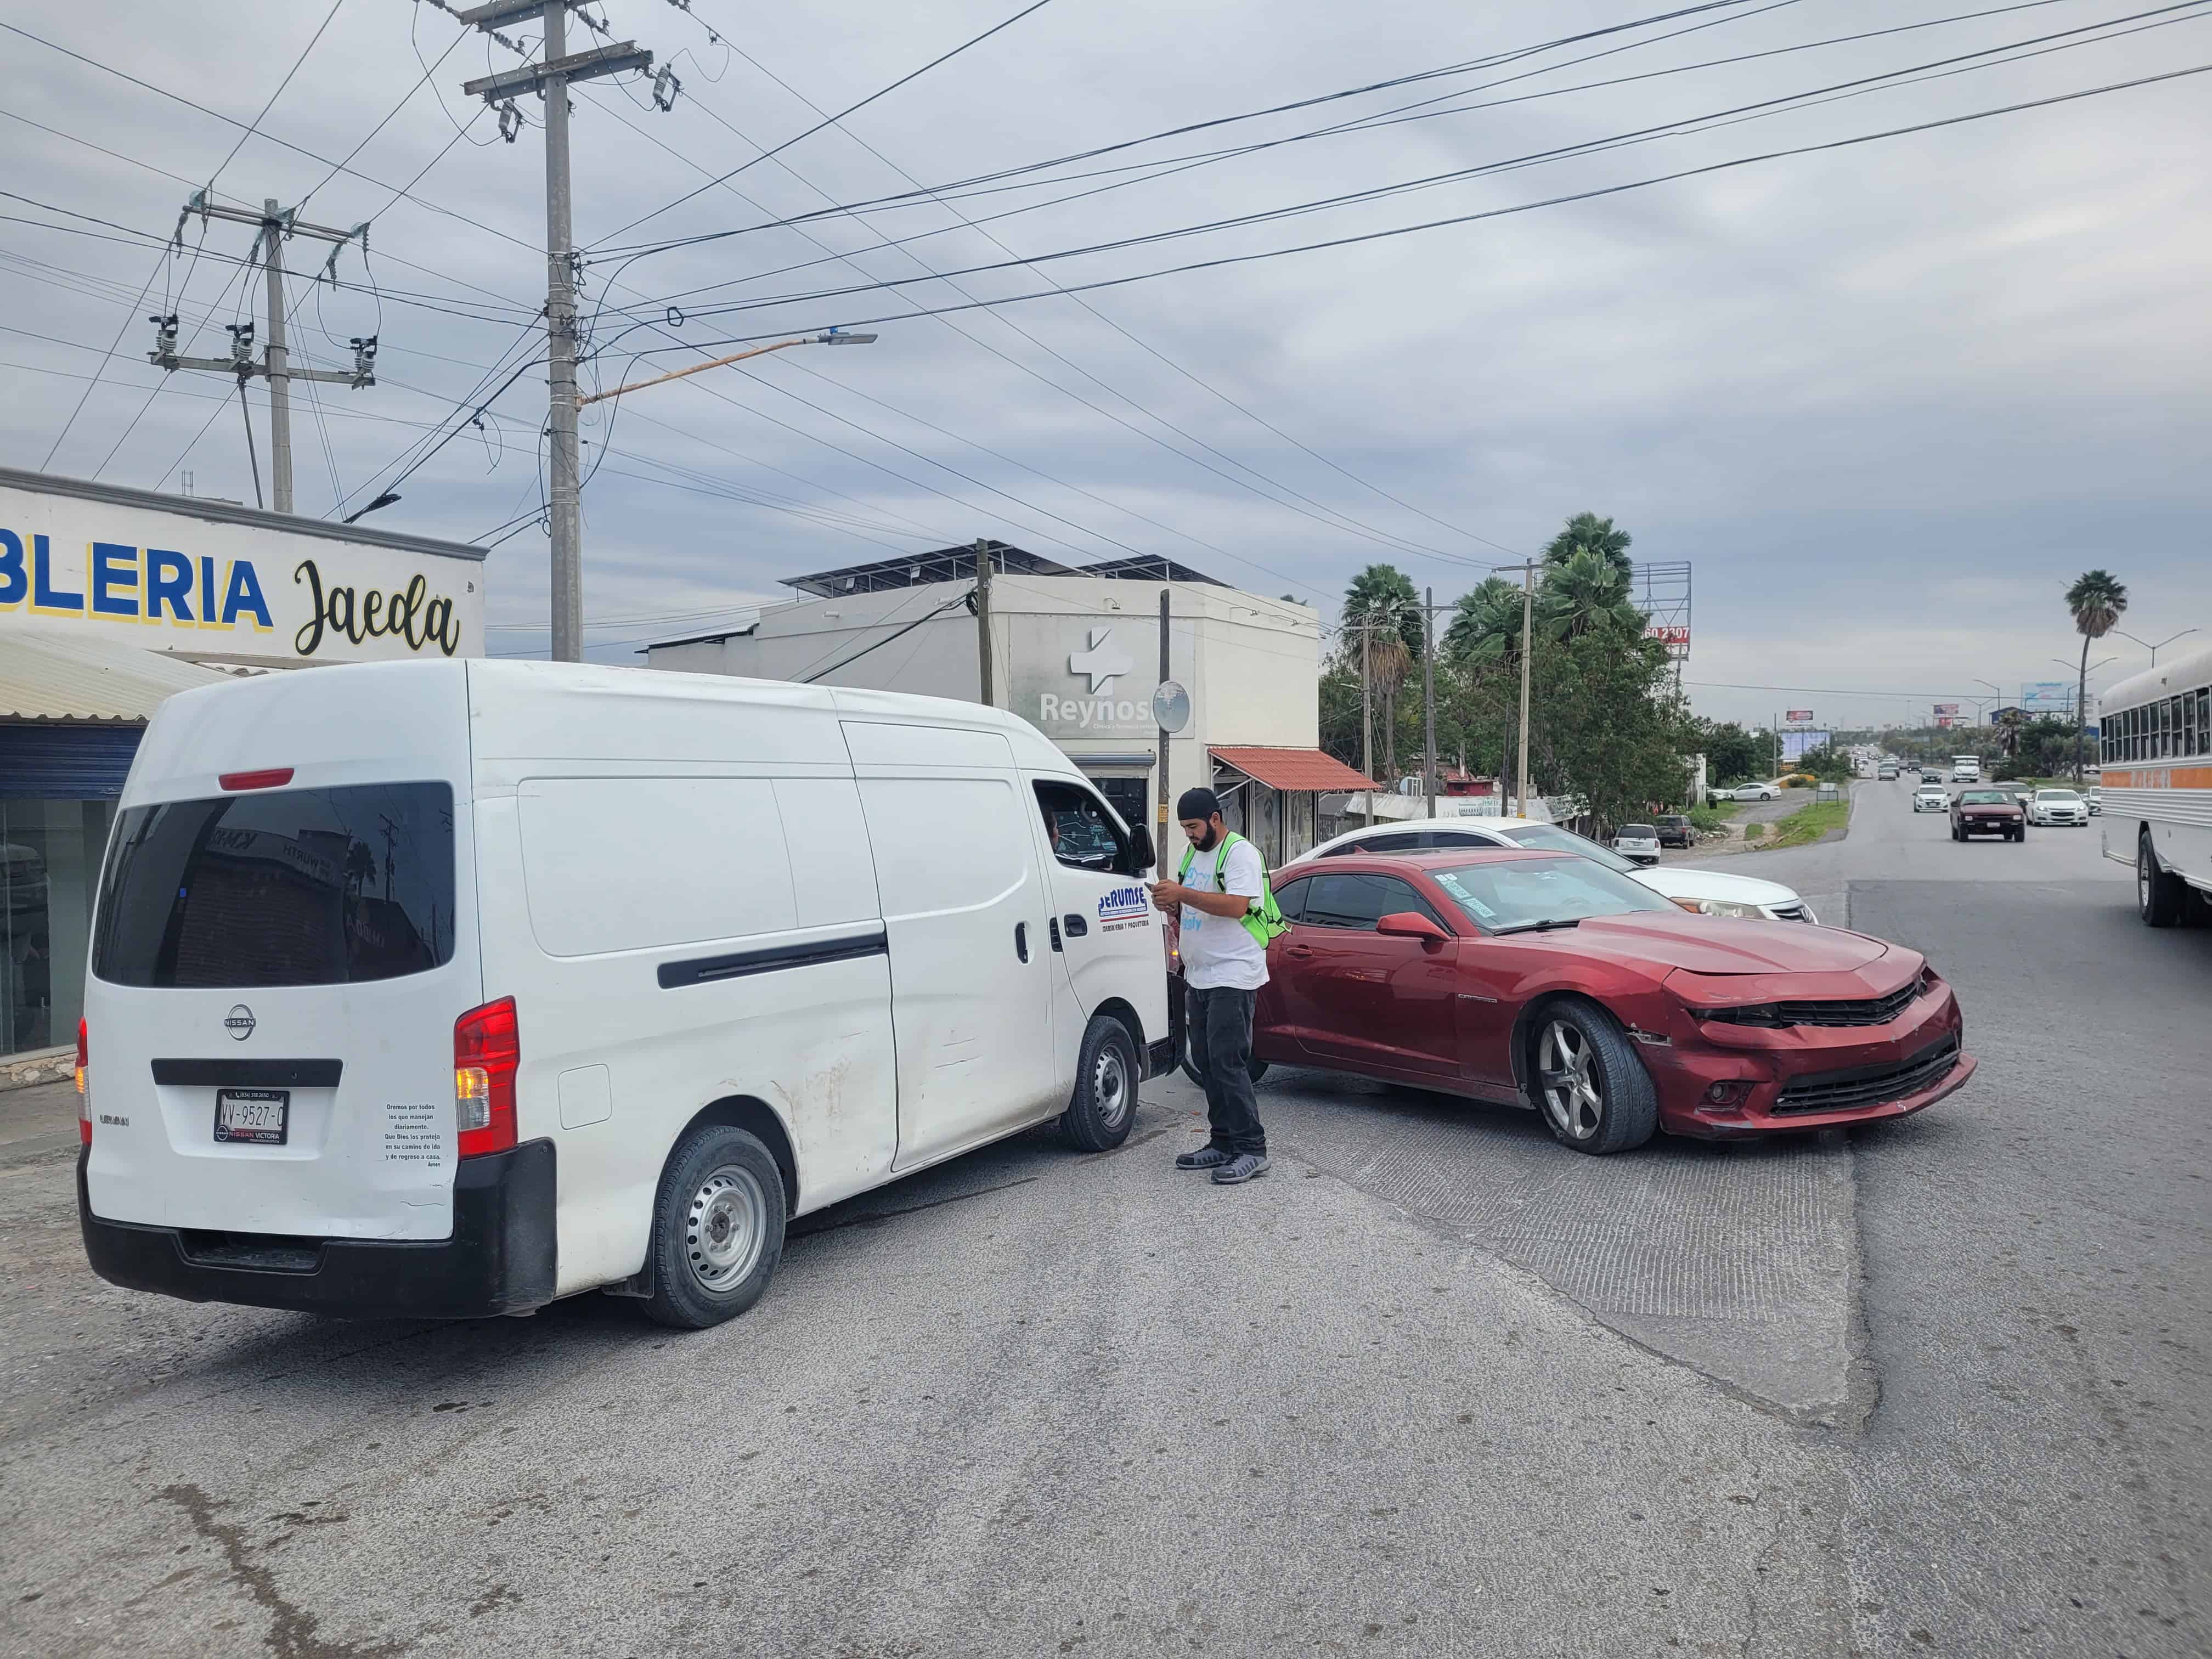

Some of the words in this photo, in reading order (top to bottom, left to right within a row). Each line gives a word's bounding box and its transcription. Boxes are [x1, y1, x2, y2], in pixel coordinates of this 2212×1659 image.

[294, 558, 460, 657] Jaeda
[1662, 627, 1689, 639] 2307
[255, 1132, 280, 1140] VICTORIA
